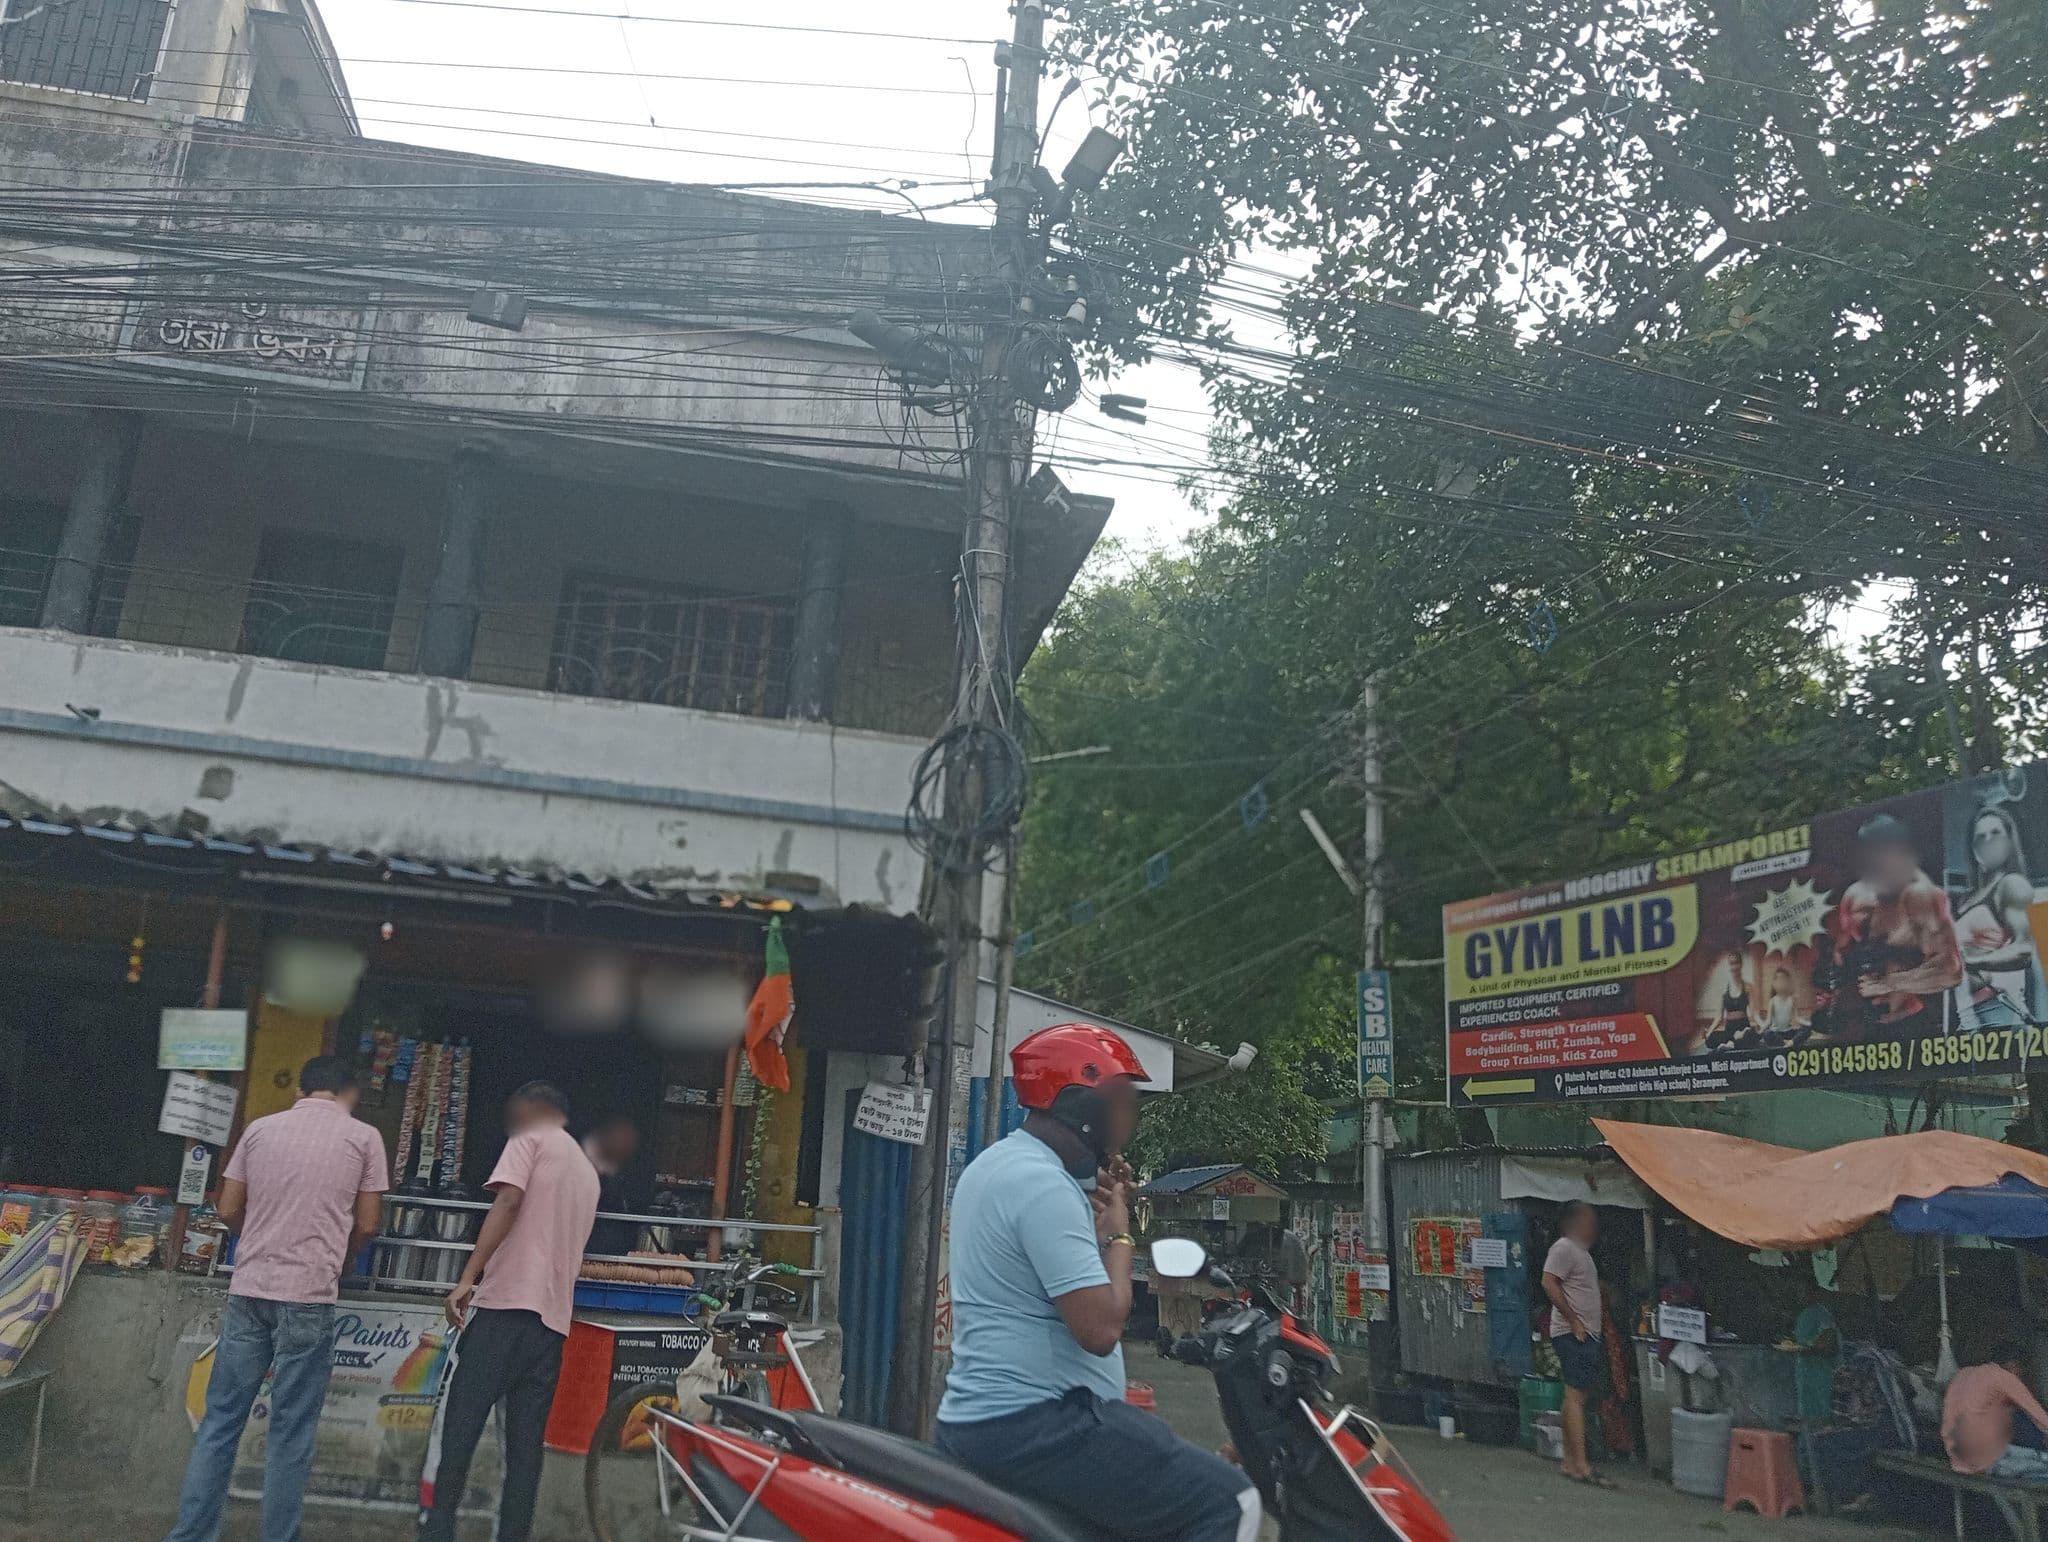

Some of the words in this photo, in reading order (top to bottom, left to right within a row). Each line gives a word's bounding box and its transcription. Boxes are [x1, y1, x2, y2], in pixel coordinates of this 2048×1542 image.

[1565, 862, 1651, 900] HOOGHLY
[1465, 916, 1562, 980] GYM
[1578, 897, 1675, 962] LNB
[1469, 985, 1477, 994] A
[1479, 983, 1498, 993] Unit
[1500, 981, 1511, 991] of
[1513, 975, 1557, 990] Physical
[1560, 970, 1580, 982] and
[1583, 966, 1620, 979] Mental
[1625, 959, 1669, 971] Fitness
[1459, 999, 1505, 1014] IMPORTED
[1566, 982, 1619, 1000] CERTIFIED
[1460, 1011, 1521, 1027] EXPERIENCED
[1481, 1030, 1516, 1043] Cardio,
[1520, 1025, 1565, 1040] Strength
[1569, 1020, 1616, 1034] Training
[1361, 1040, 1390, 1055] HEALTH
[1465, 1042, 1532, 1057] Bodybuilding,
[1608, 1031, 1636, 1044] Yoga
[1366, 1058, 1387, 1073] CARE
[1481, 1057, 1510, 1069] Group
[1513, 1053, 1559, 1066] Training,
[1563, 1049, 1586, 1061] Kids
[1589, 1048, 1617, 1059] Zone
[1787, 1041, 1902, 1077] 6291845858
[1907, 1040, 1915, 1071] /
[1586, 1070, 1598, 1080] Post
[1600, 1069, 1616, 1079] Office
[1692, 1062, 1710, 1074] Lane,
[1711, 1060, 1728, 1072] Misti
[1580, 1084, 1598, 1095] Before
[1599, 1082, 1638, 1094] Parameshwari
[1639, 1080, 1652, 1091] Girls
[1653, 1079, 1667, 1093] High
[334, 1313, 412, 1349] Paints
[661, 1334, 699, 1350] TOBACCO
[334, 1352, 361, 1365] ices
[613, 1373, 641, 1382] INTENSE
[642, 1374, 656, 1383] CLO
[620, 1364, 635, 1374] RICH
[637, 1365, 669, 1375] TOBACCO
